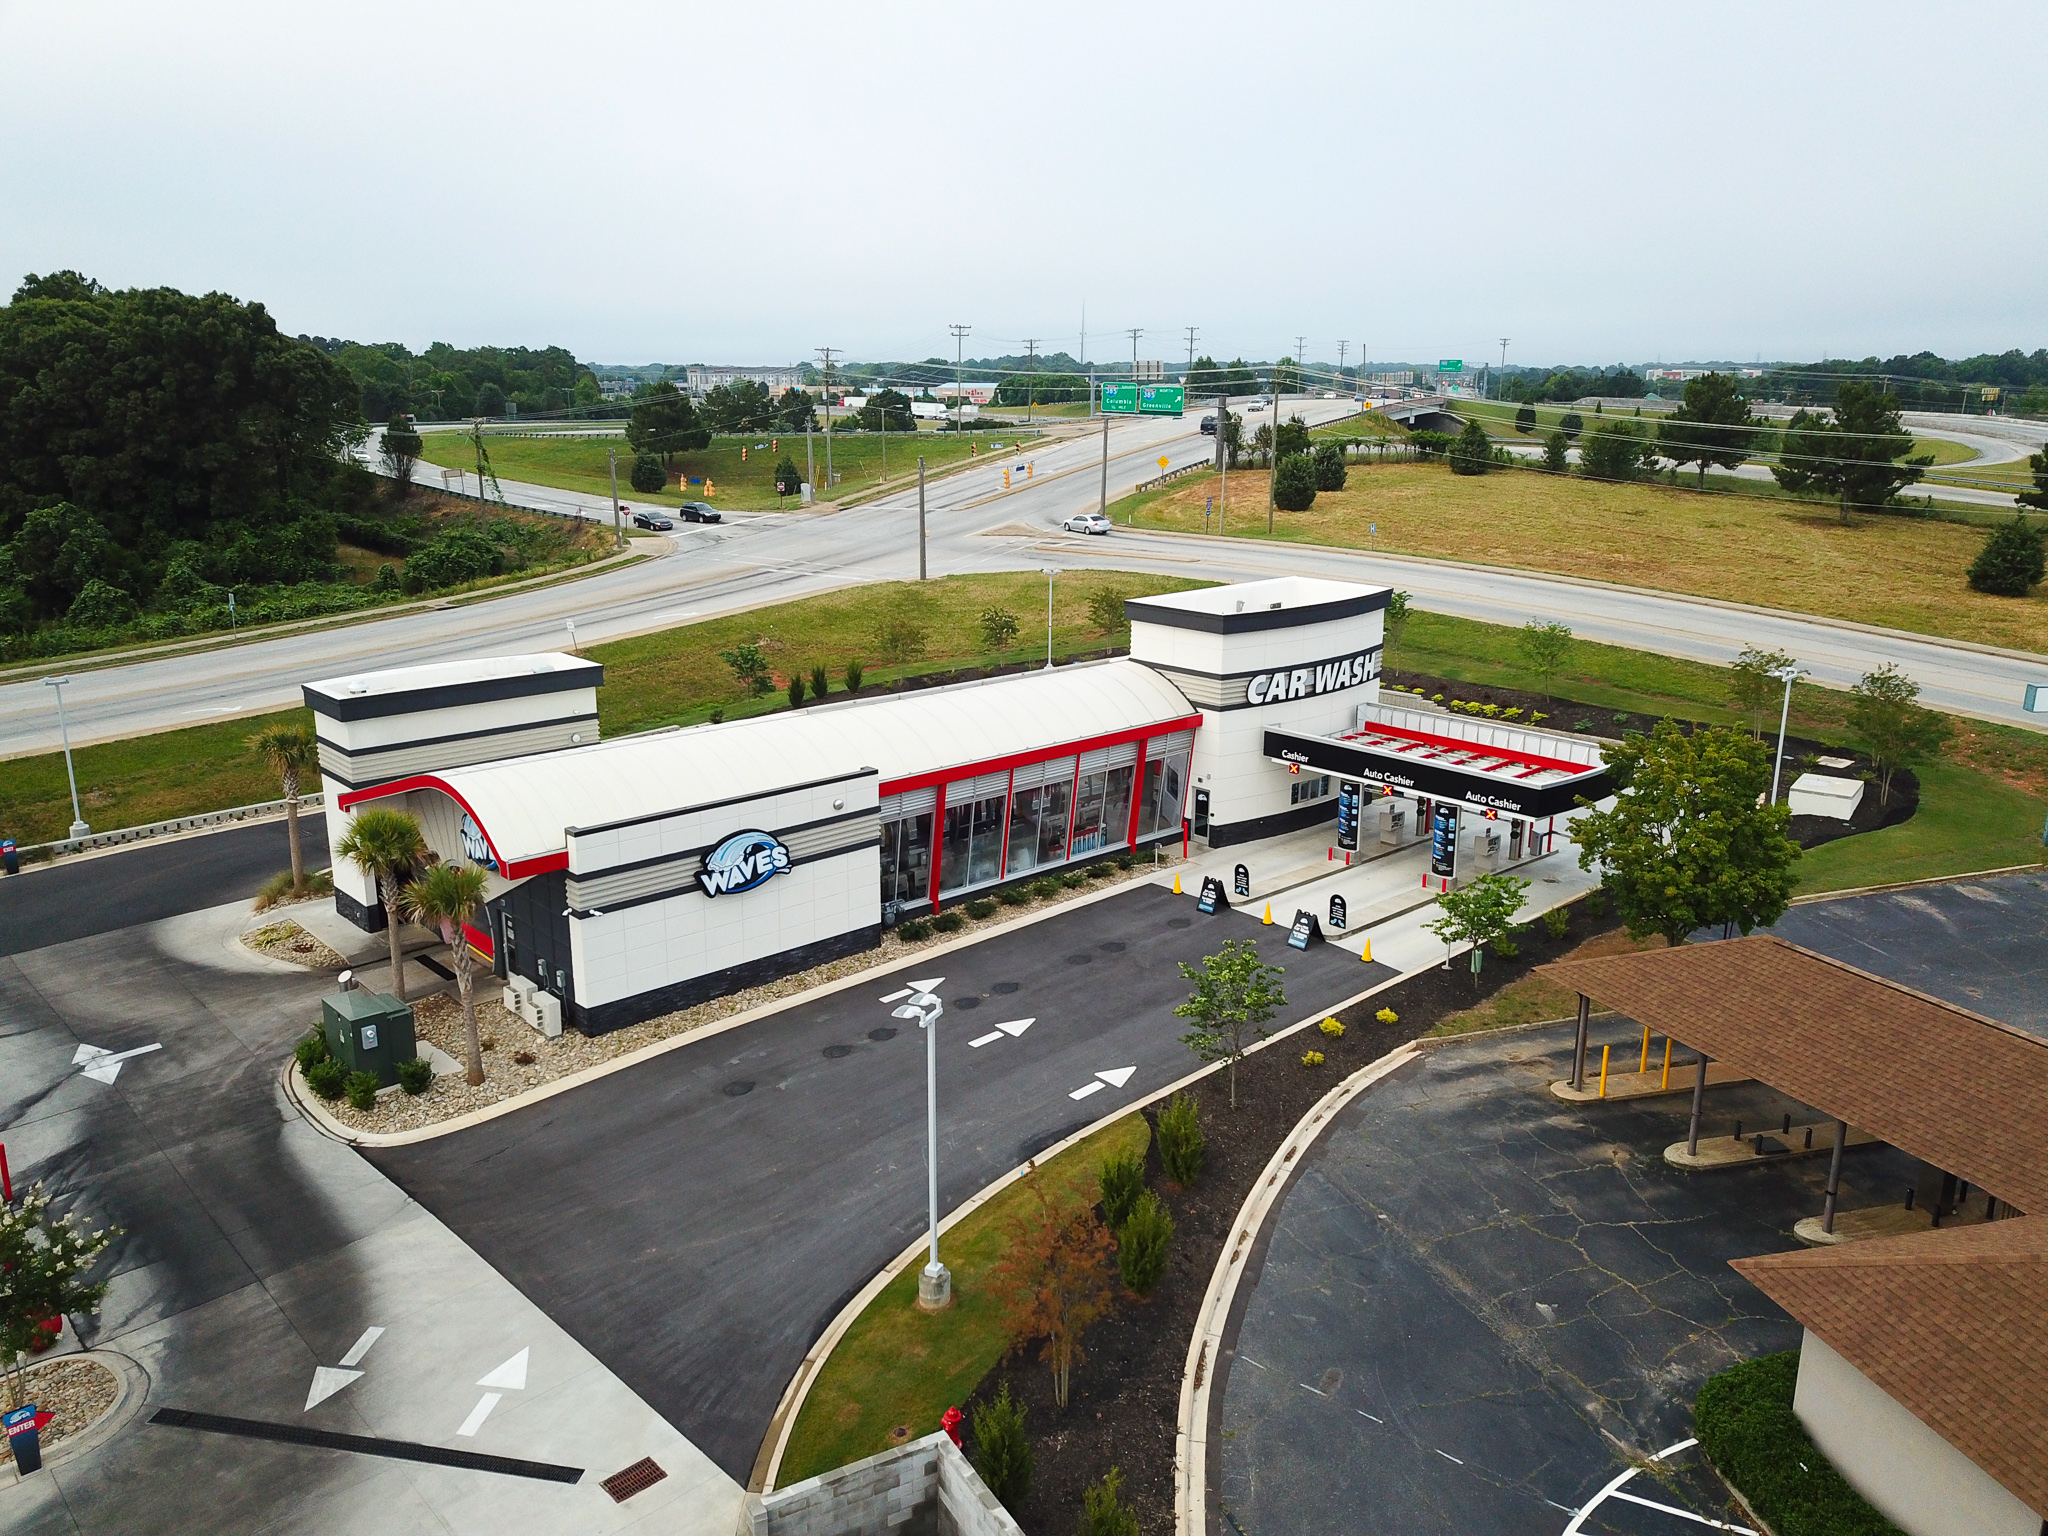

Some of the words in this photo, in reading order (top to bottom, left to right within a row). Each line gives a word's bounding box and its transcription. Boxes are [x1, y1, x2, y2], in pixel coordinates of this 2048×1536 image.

[1247, 668, 1308, 705] CAR
[1315, 652, 1376, 694] WASH
[1281, 749, 1309, 763] Cashier
[1363, 768, 1383, 780] Auto
[1384, 772, 1415, 787] Cashier
[1465, 790, 1487, 804] Auto
[1488, 795, 1521, 811] Cashier
[700, 846, 788, 896] WAVES
[8, 1419, 36, 1436] ENTER
